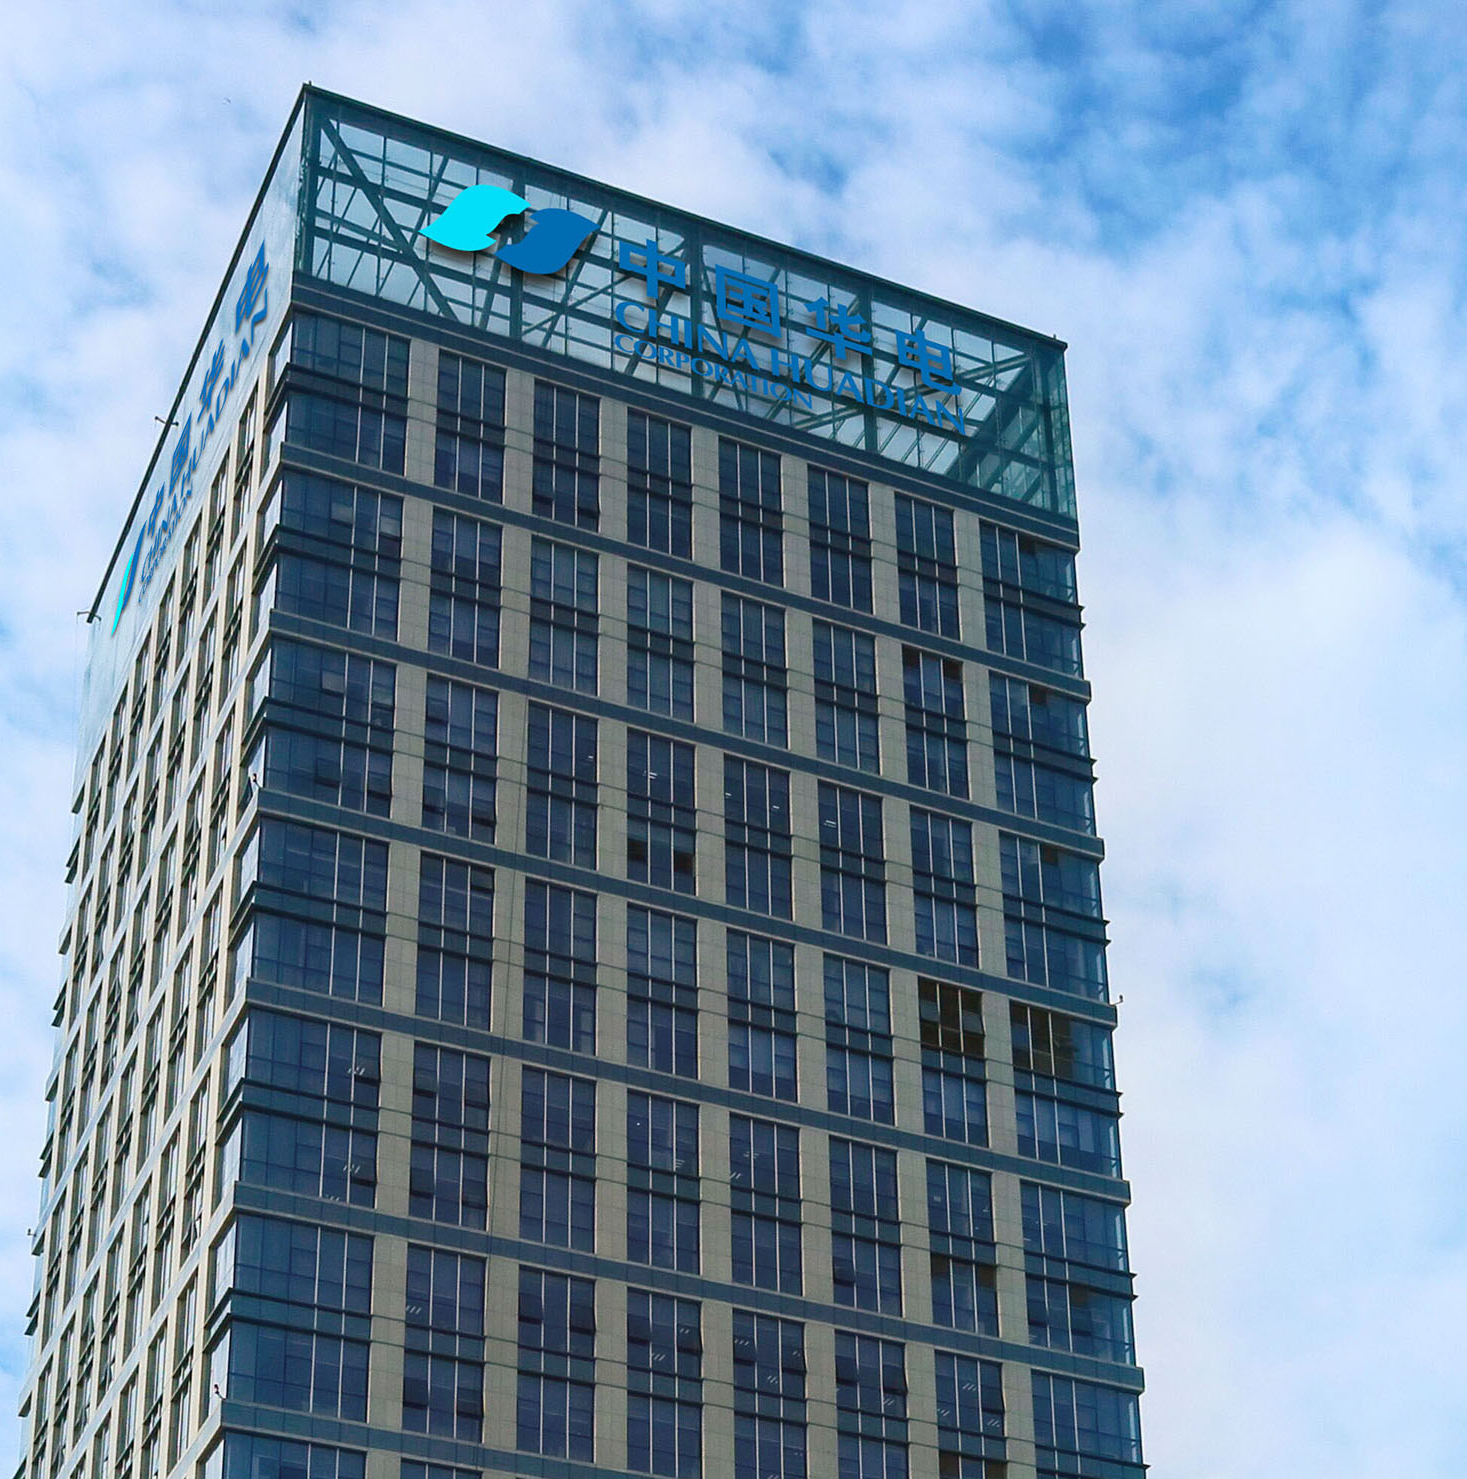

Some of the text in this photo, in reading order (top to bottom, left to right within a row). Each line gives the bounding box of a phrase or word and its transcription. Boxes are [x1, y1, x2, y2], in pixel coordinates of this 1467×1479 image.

[148, 239, 269, 538] 中国华电
[614, 334, 814, 409] CORPORATION
[615, 301, 966, 436] CHINA HUADIAN
[619, 239, 962, 396] 中国华电
[141, 287, 268, 583] CHINA HUADIAN
[138, 479, 193, 604] CORPORATION
